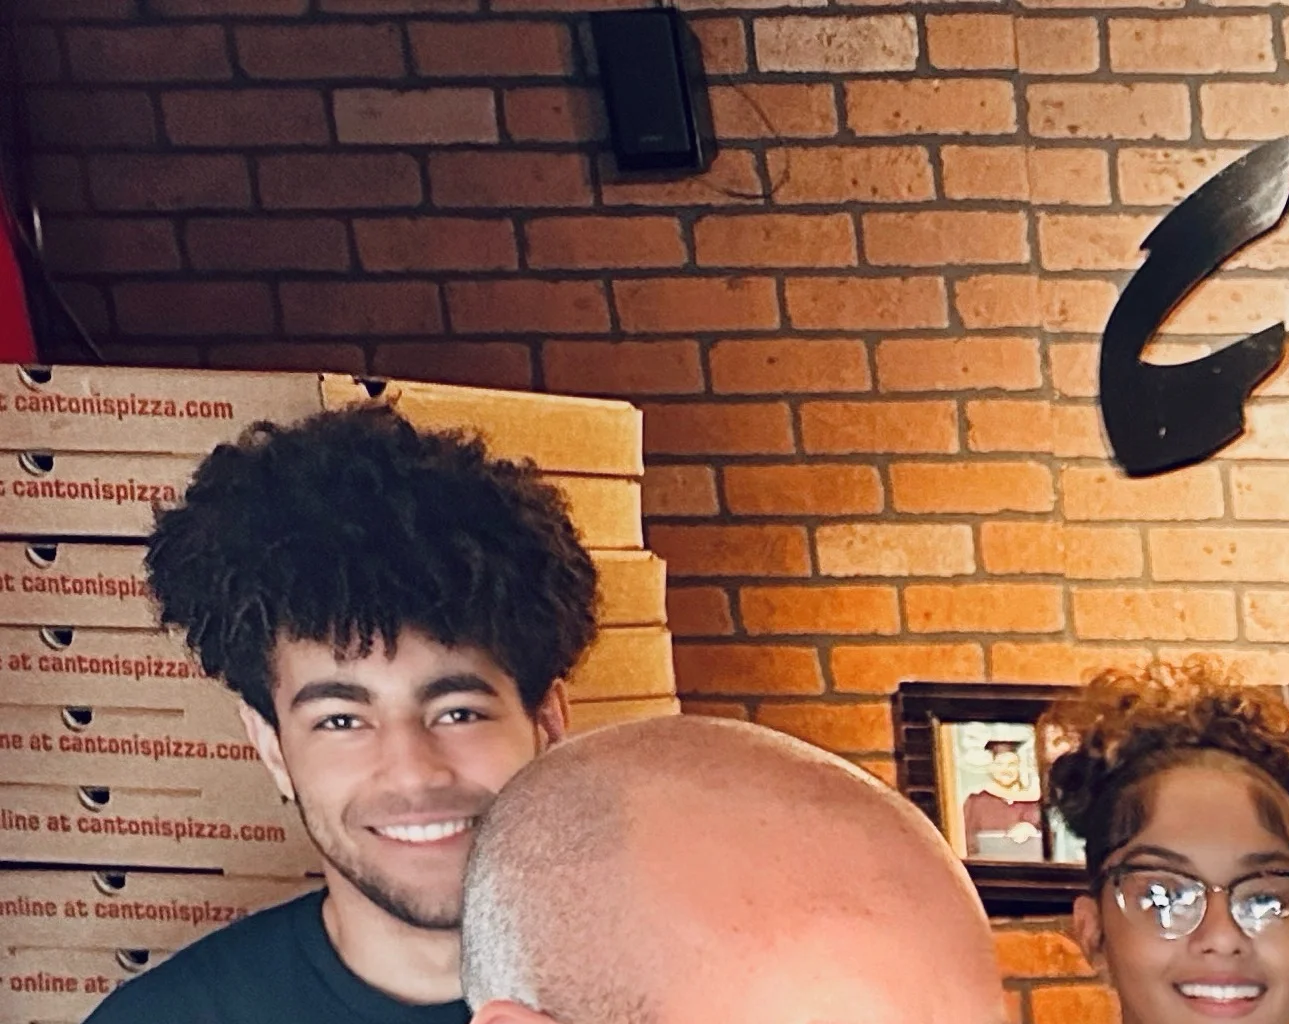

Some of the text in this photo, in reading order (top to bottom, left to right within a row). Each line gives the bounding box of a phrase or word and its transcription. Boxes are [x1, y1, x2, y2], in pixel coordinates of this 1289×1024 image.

[14, 393, 234, 420] cantonispizza.com
[8, 653, 32, 671] at
[30, 733, 52, 751] at
[59, 734, 262, 761] cantonispizza.com
[47, 813, 71, 832] at
[77, 815, 286, 843] cantonispizza.com
[0, 896, 58, 917] nline
[64, 899, 89, 918] at
[10, 971, 78, 992] online
[84, 975, 110, 993] at
